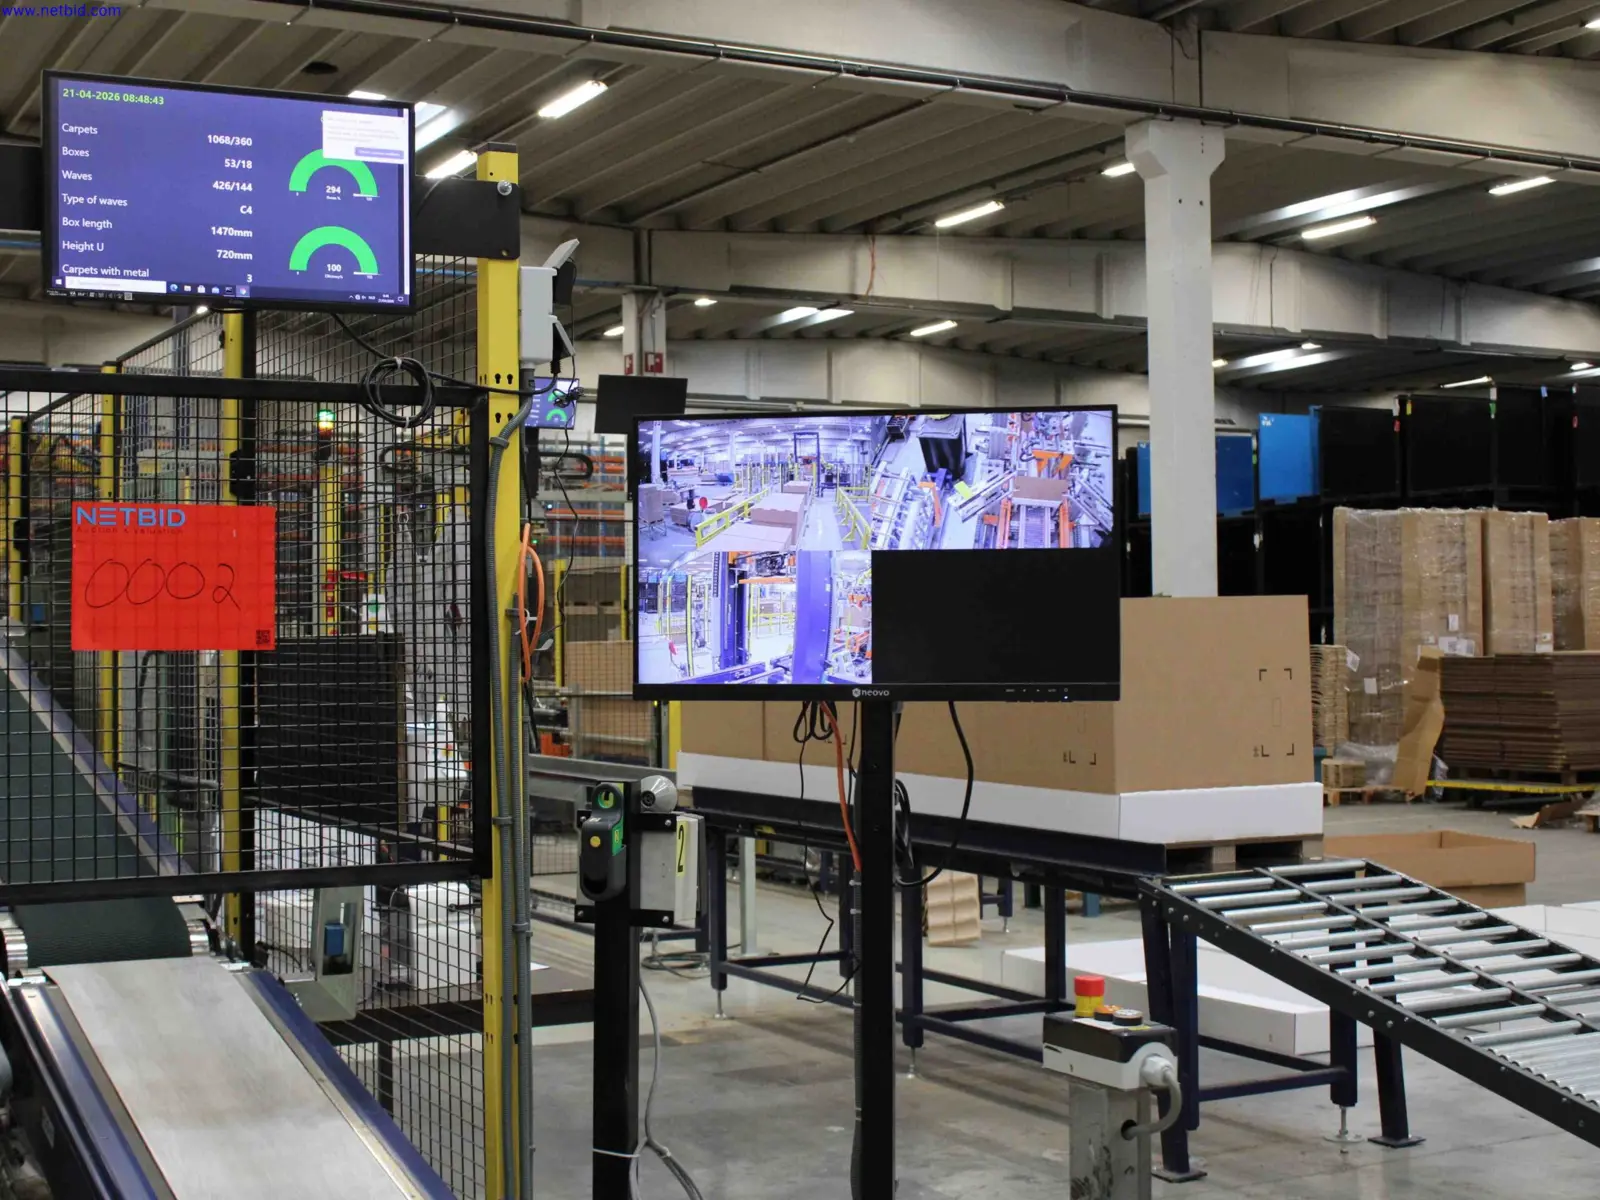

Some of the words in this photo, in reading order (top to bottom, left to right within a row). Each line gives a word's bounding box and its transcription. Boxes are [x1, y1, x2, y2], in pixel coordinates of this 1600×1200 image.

[62, 88, 120, 101] 21-04-2026
[123, 93, 164, 105] 08:48:43
[62, 123, 98, 135] Carpets
[207, 134, 253, 147] 1068/360
[62, 147, 90, 157] Boxes
[224, 159, 253, 170] 53/18
[62, 170, 92, 181] Waves
[213, 181, 253, 192] 426/144
[325, 185, 342, 195] 294
[62, 193, 85, 205] Type
[87, 195, 97, 204] of
[99, 197, 128, 206] waves
[239, 205, 253, 215] C4
[62, 217, 80, 227] Box
[82, 218, 113, 230] length
[211, 226, 253, 238] 1470mm
[62, 240, 94, 252] Height
[97, 243, 105, 252] U
[216, 249, 253, 260] 720mm
[62, 264, 98, 276] Carpets
[101, 266, 121, 276] with
[123, 268, 150, 278] metal
[326, 263, 342, 273] 100
[246, 274, 253, 283] 3
[76, 506, 186, 527] NETBID
[84, 558, 242, 612] 0002
[861, 689, 890, 697] neovo
[676, 824, 686, 873] 2
